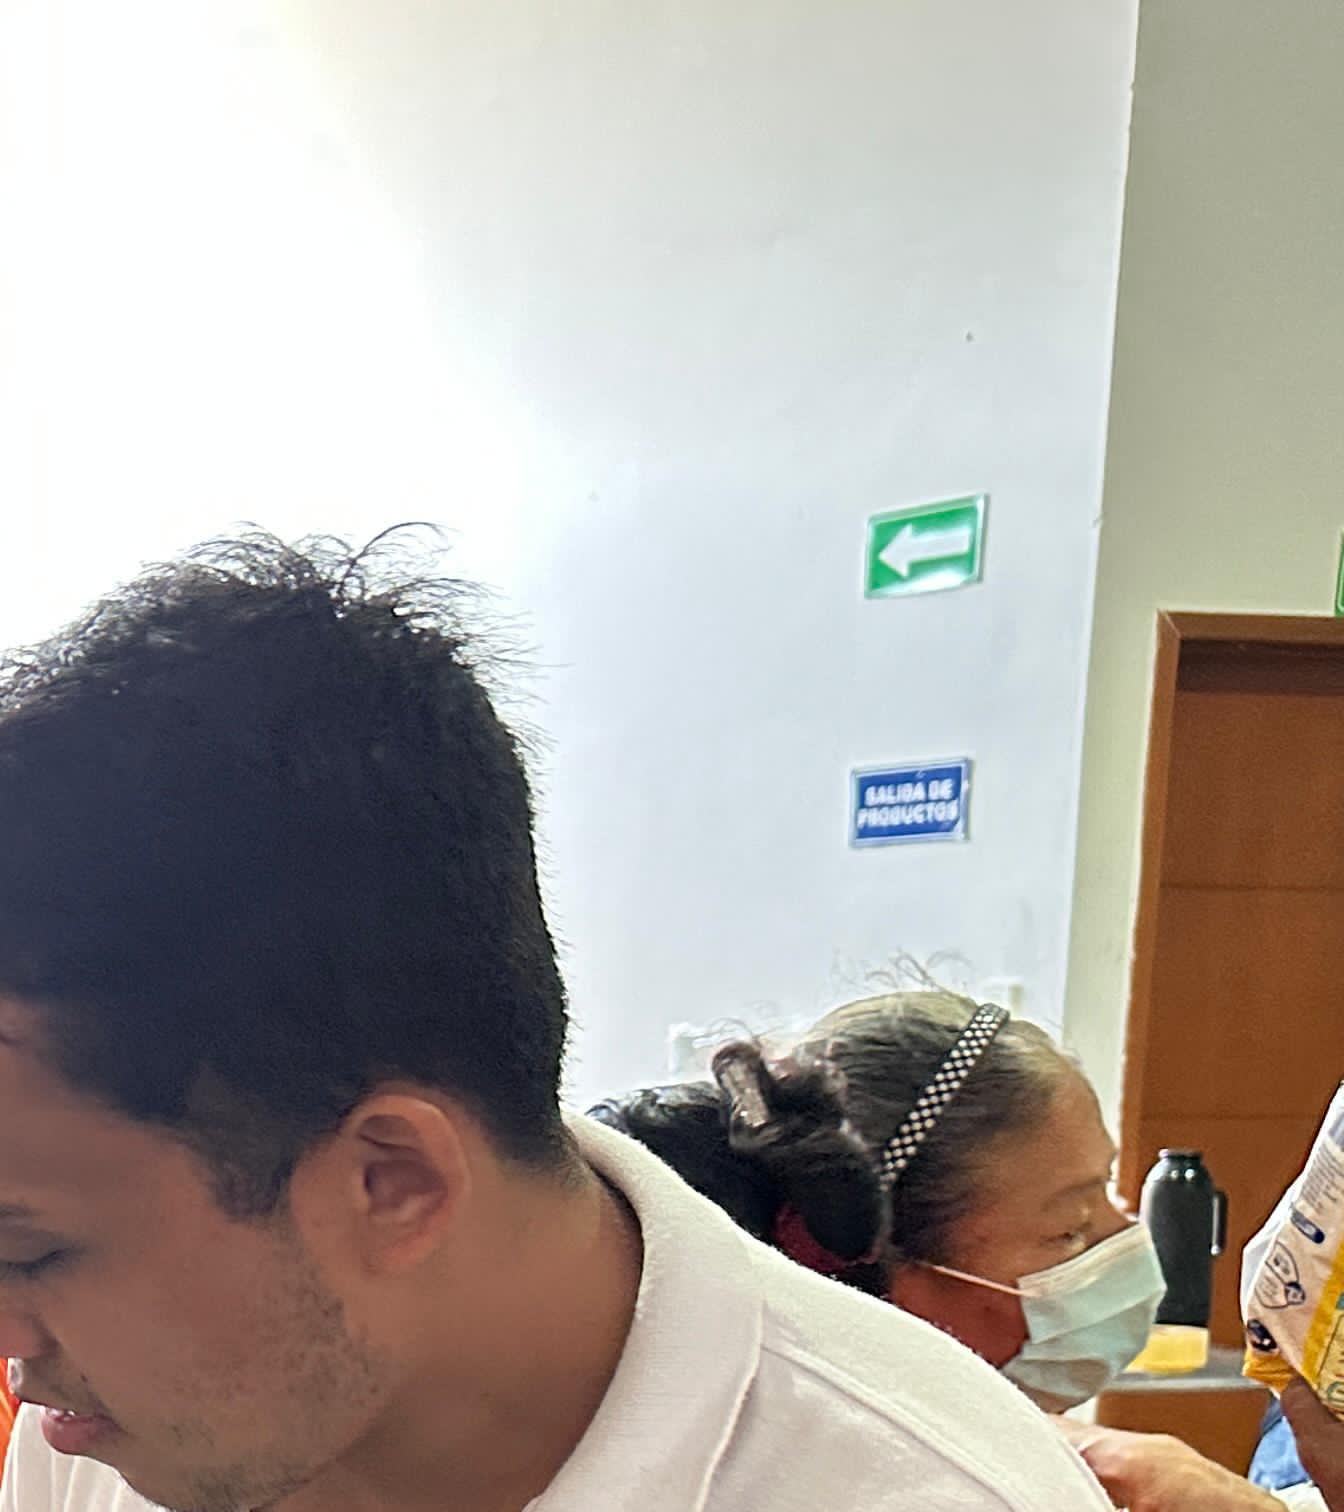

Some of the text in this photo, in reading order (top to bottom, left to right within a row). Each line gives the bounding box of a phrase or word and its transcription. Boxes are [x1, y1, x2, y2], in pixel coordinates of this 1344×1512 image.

[865, 778, 953, 806] SALIDA DE
[857, 799, 959, 829] PRODUCTOS
